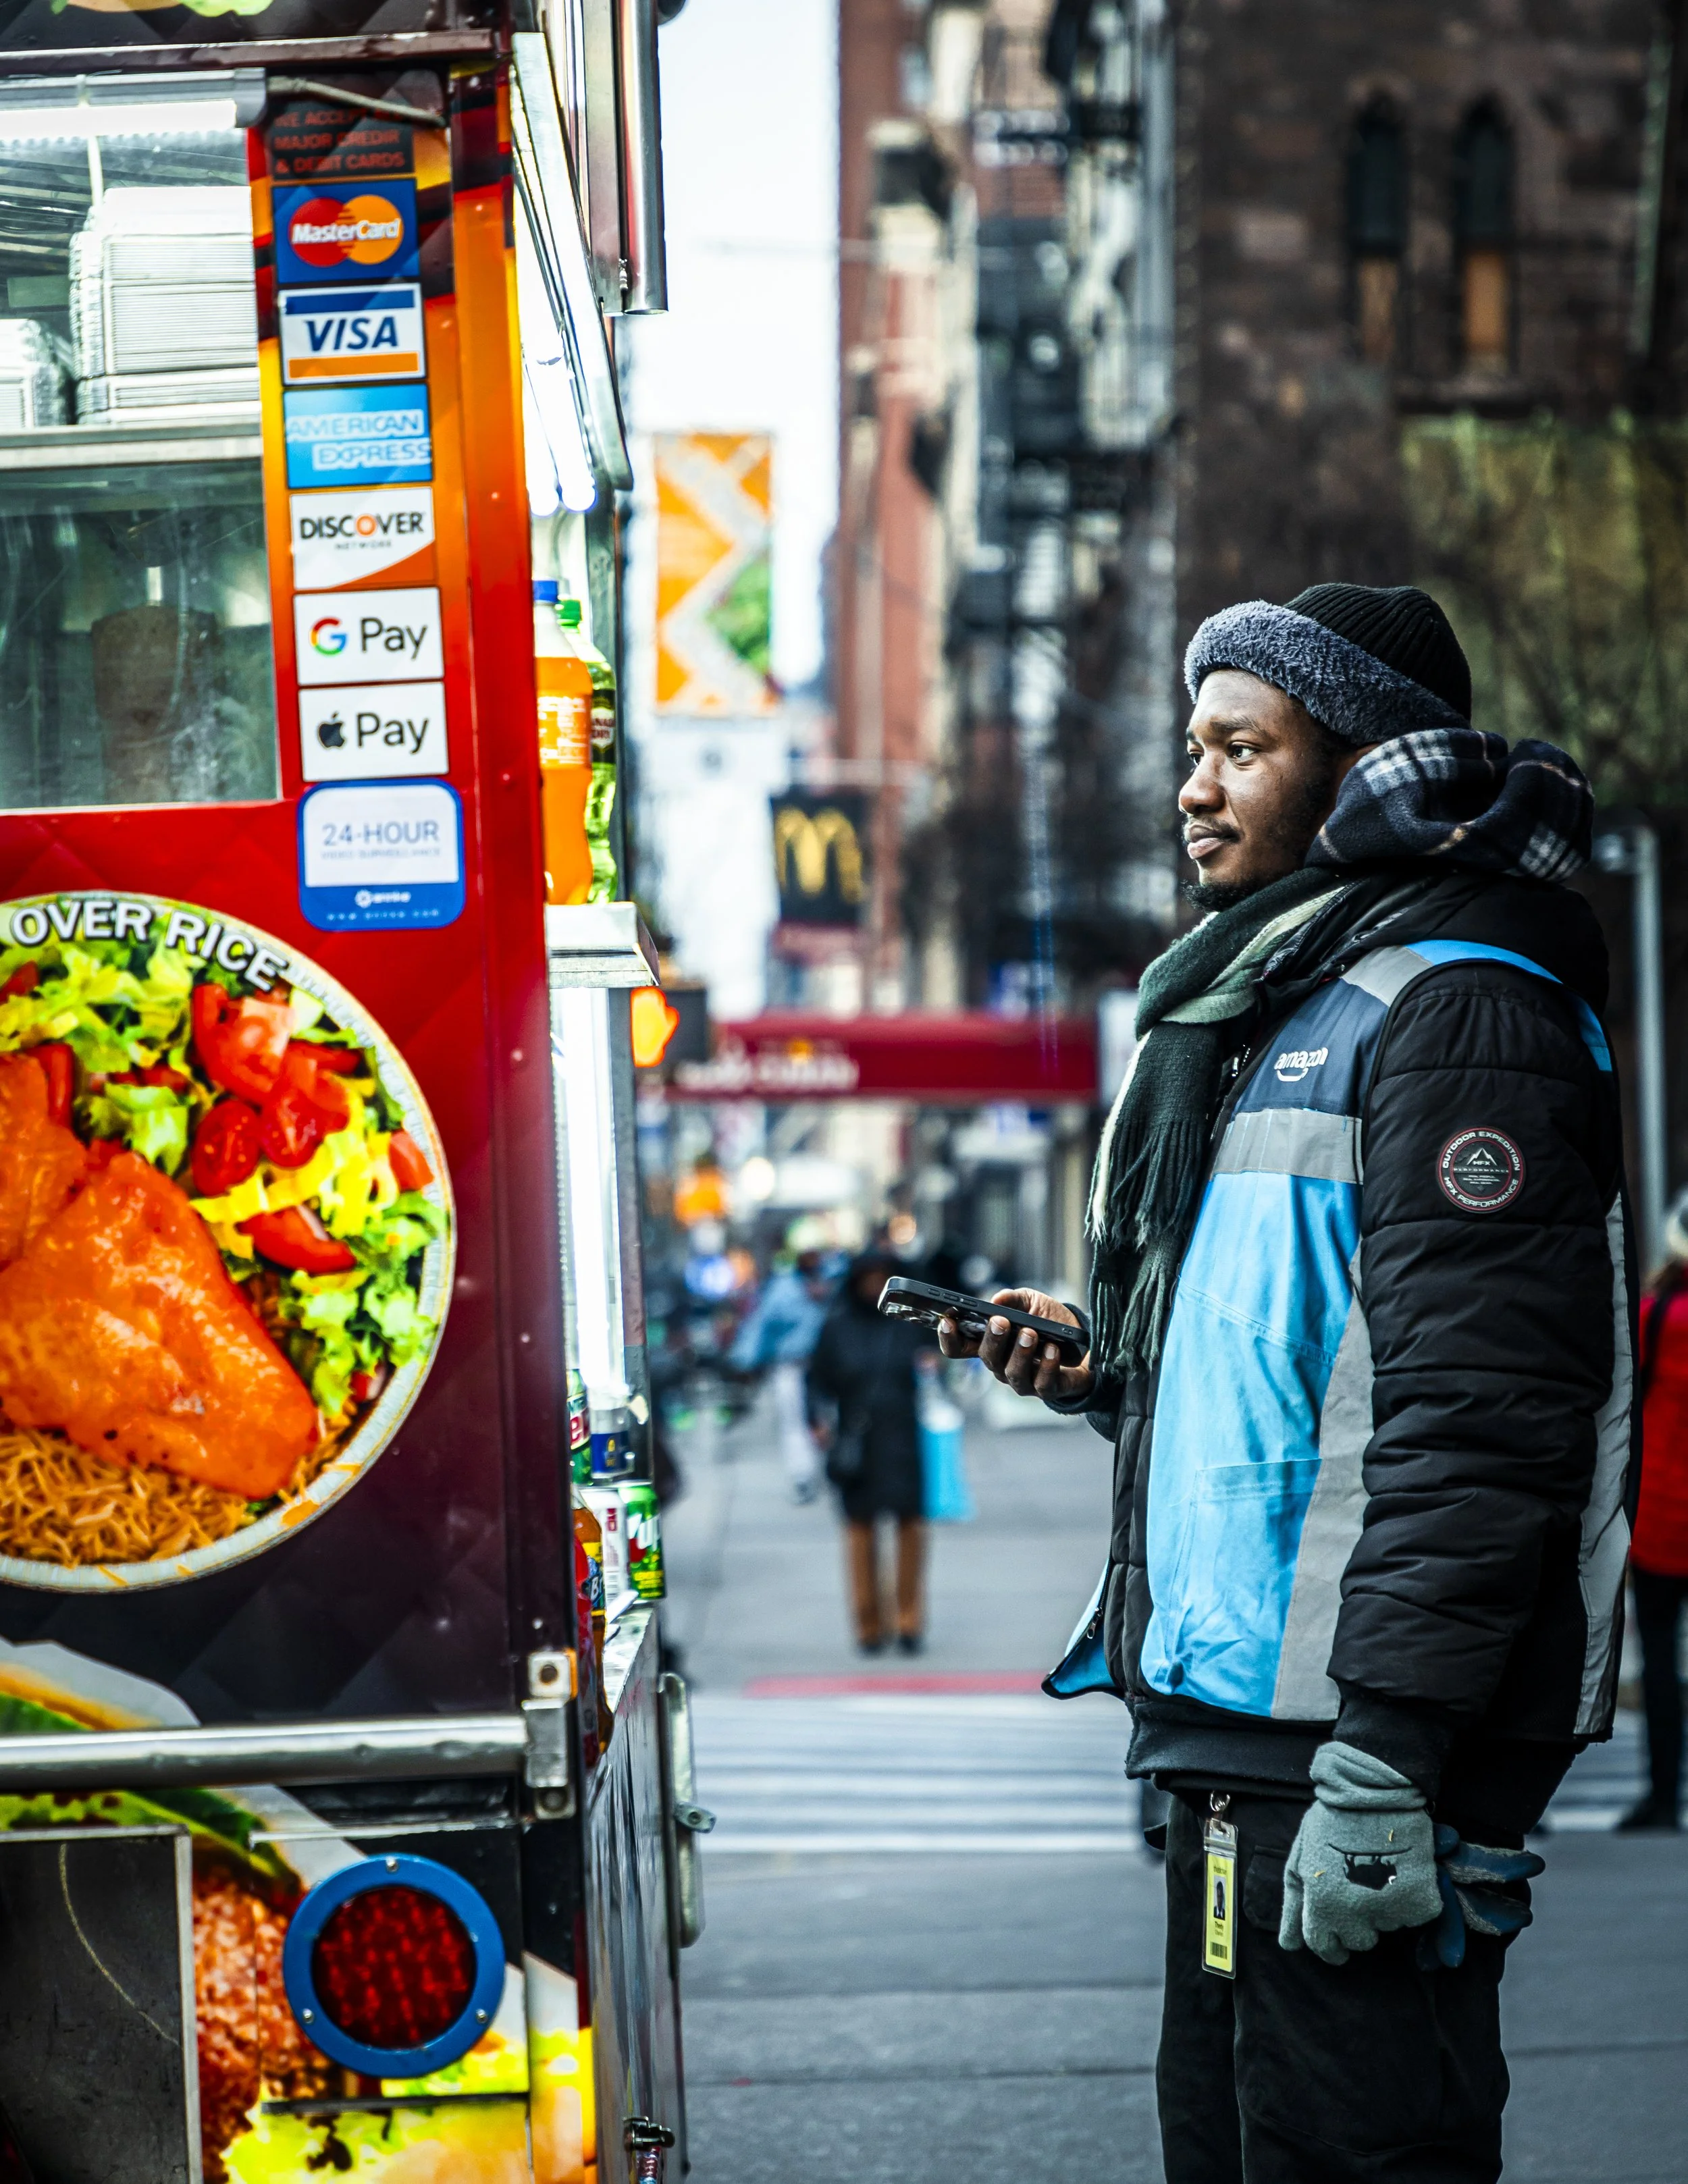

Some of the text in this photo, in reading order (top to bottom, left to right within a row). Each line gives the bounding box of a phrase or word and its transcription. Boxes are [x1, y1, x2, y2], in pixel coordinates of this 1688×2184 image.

[273, 132, 332, 150] MAJOR
[346, 151, 405, 169] CARDS
[292, 218, 401, 244] MasterCard
[305, 316, 398, 352] VISA
[287, 410, 421, 437] AMERICAN
[316, 440, 431, 467] EXPRESS
[299, 512, 425, 540] DISCOVER
[360, 616, 428, 660] Pay
[355, 712, 429, 755] Pay
[321, 820, 440, 846] 24-HOUR
[11, 899, 289, 992] OVER RICE
[1442, 1131, 1521, 1171] OUTDOOR EXPEDITION
[1457, 1179, 1519, 1207] PERFORMANCE
